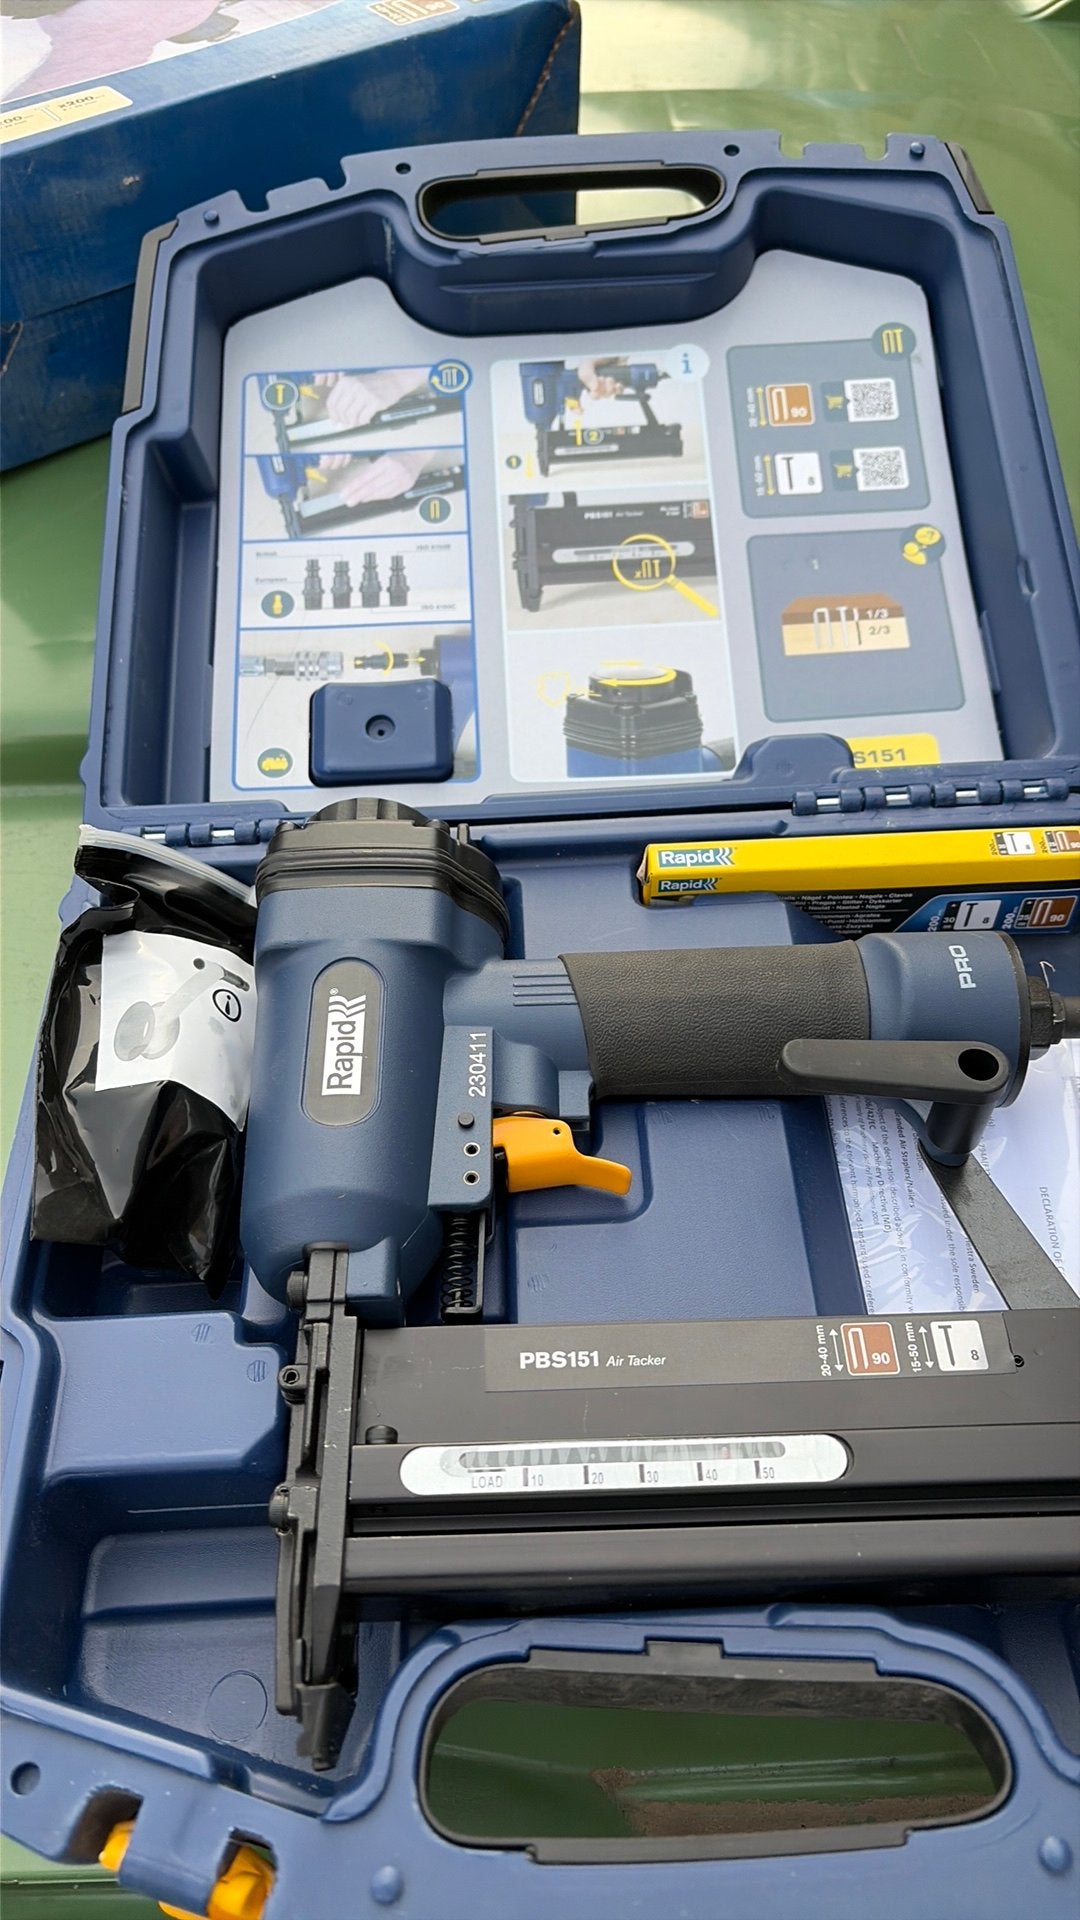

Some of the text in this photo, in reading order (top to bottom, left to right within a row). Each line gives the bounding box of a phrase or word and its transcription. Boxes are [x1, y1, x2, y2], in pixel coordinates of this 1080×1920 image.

[866, 608, 889, 619] 1/3
[868, 625, 890, 636] 2/3
[660, 849, 716, 867] Rapid
[660, 879, 702, 892] Rapid
[943, 916, 955, 924] 30
[1002, 912, 1015, 929] 200
[1049, 914, 1065, 923] 90
[948, 944, 976, 989] PRO
[326, 1020, 363, 1090] Rapid
[468, 1031, 487, 1097] 230411
[1039, 1186, 1060, 1249] DECLARATION
[948, 1242, 957, 1256] the
[950, 1257, 959, 1272] sole
[969, 1263, 980, 1293] Sweden
[904, 1321, 916, 1343] mm
[519, 1350, 666, 1369] PBS151 Air Tacker
[815, 1324, 832, 1377] 20-40 mm
[871, 1352, 890, 1365] 90
[907, 1343, 922, 1373] 15-50
[970, 1349, 980, 1361] 8
[471, 1466, 775, 1489] LOAD 10 20 30 40 50
